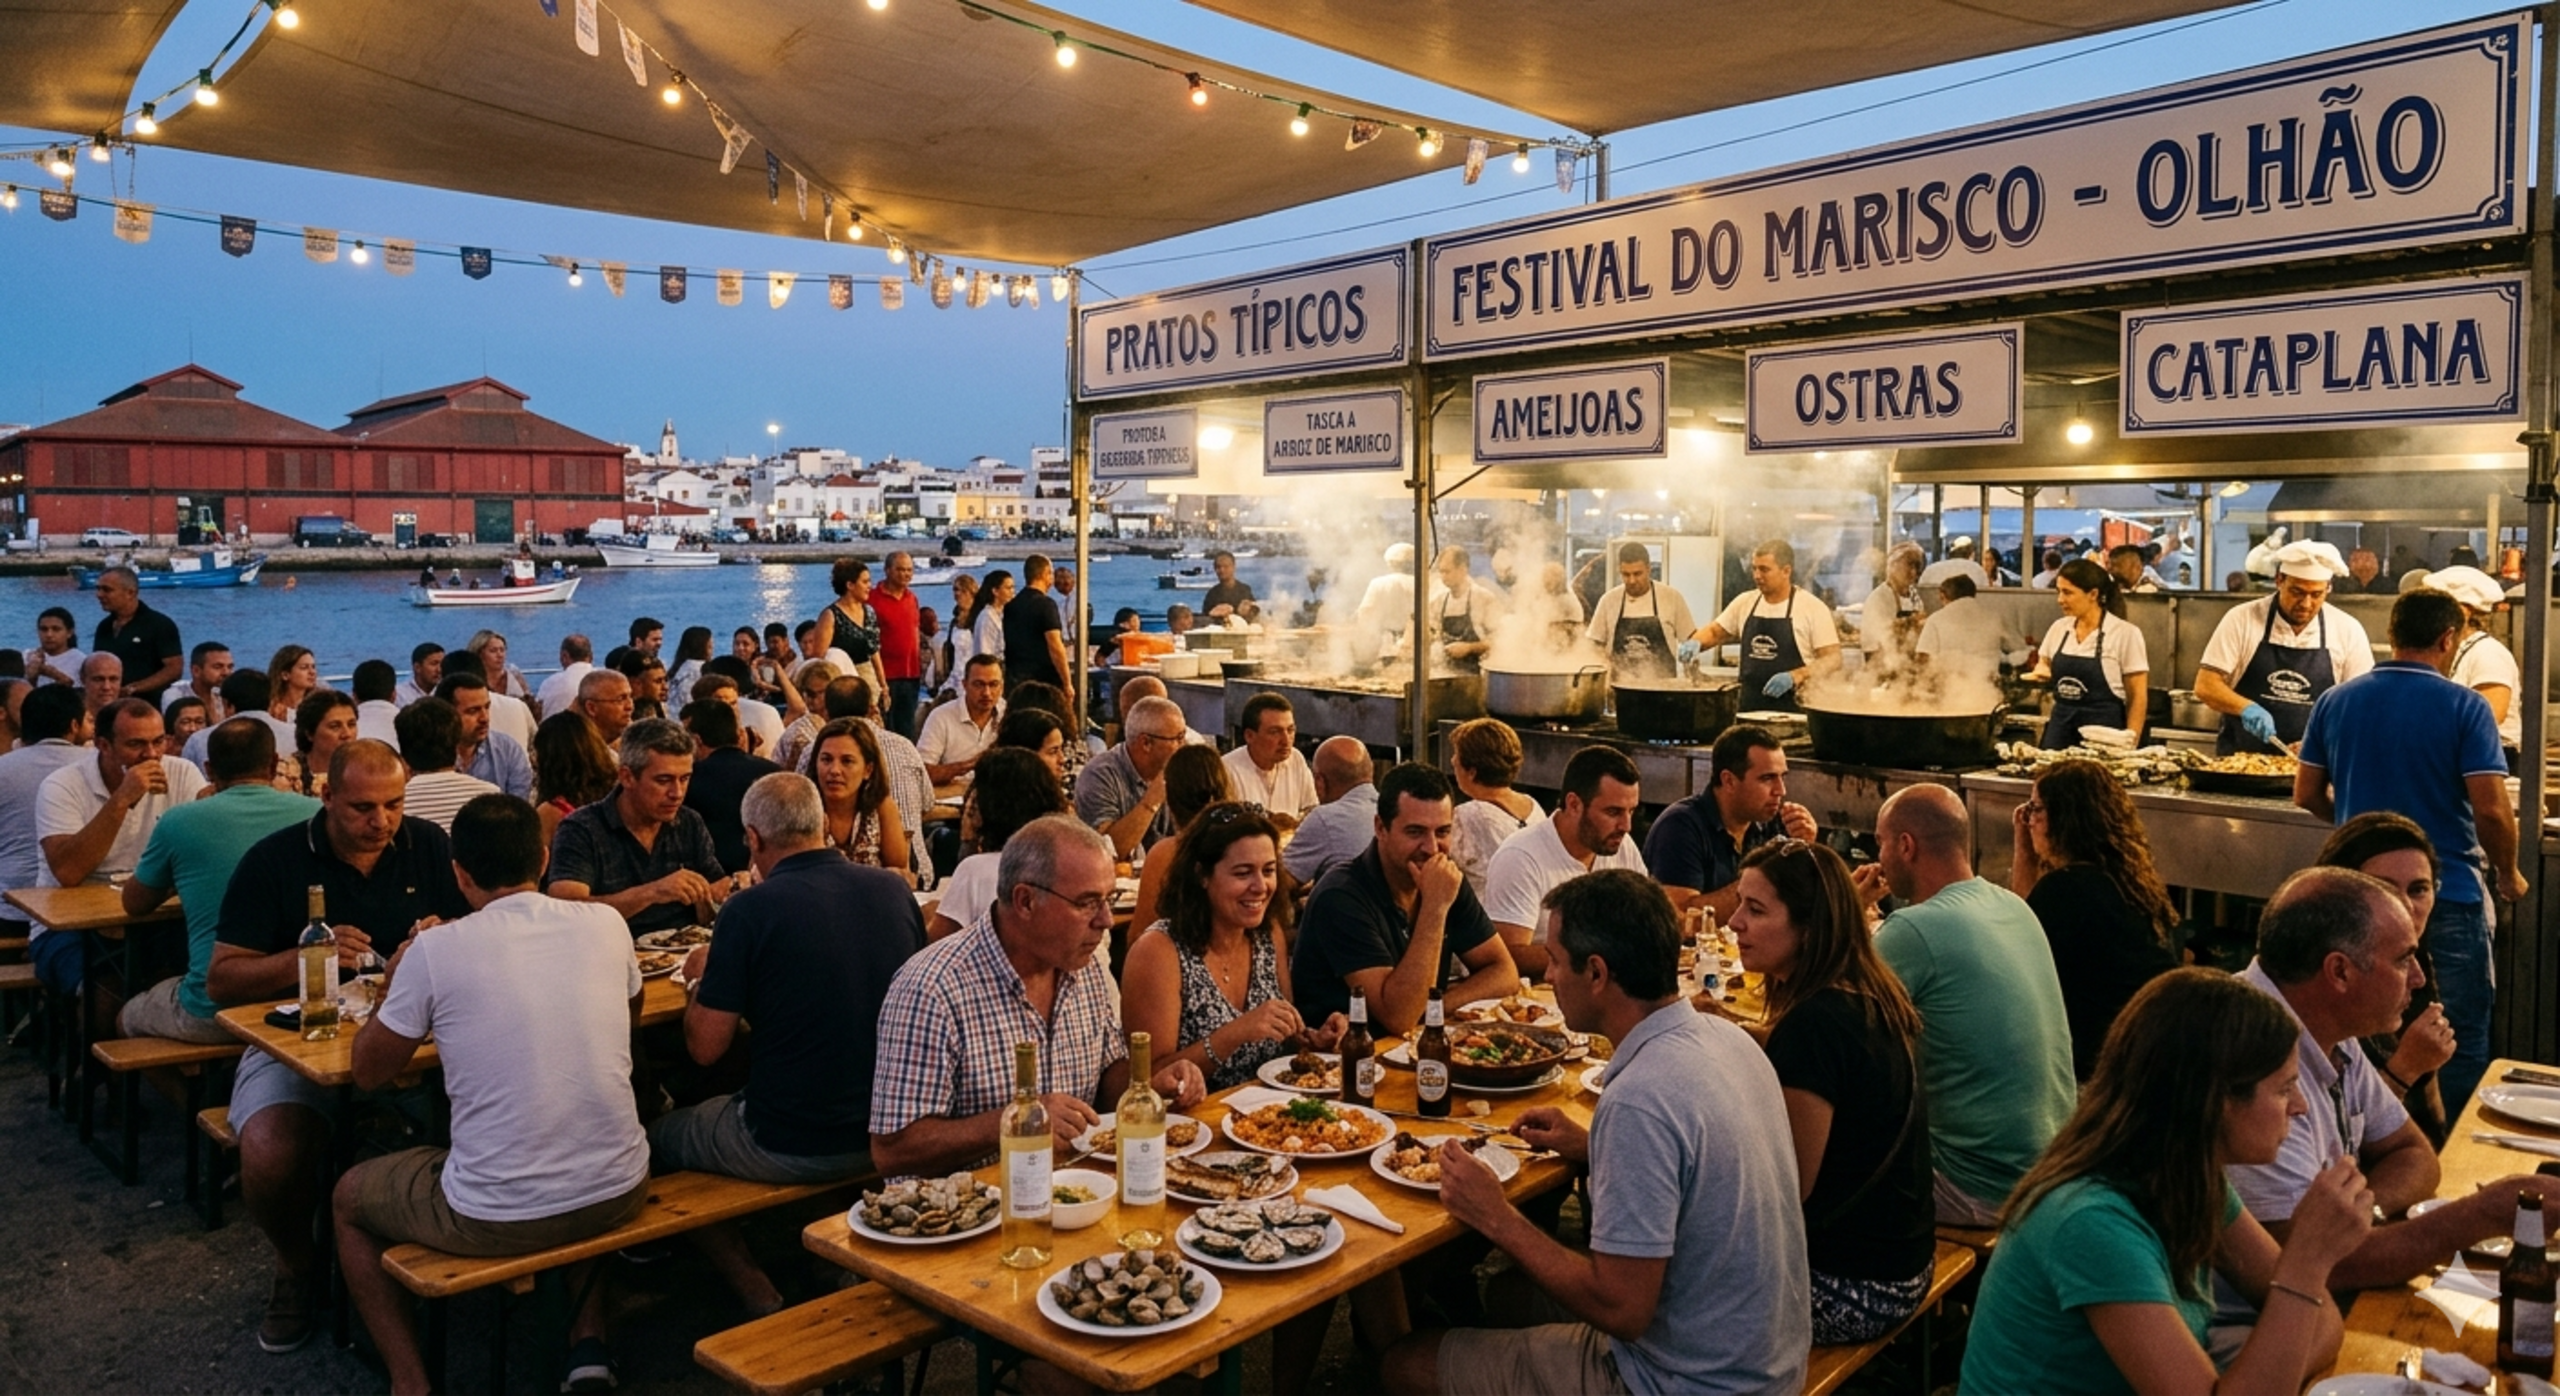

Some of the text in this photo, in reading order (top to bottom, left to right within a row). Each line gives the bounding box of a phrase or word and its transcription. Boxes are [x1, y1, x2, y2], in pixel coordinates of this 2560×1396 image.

[1452, 83, 2446, 326] FESTIVAL DO MARISCO - OLHÃO
[1106, 284, 1368, 375] PRATOS TÍPICOS
[2146, 318, 2492, 403] CATAPLANA
[1306, 410, 1357, 431] TASCA A
[1490, 386, 1645, 442] AMEIJOAS
[1795, 360, 1963, 427] OSTRAS
[1316, 437, 1332, 455] DE
